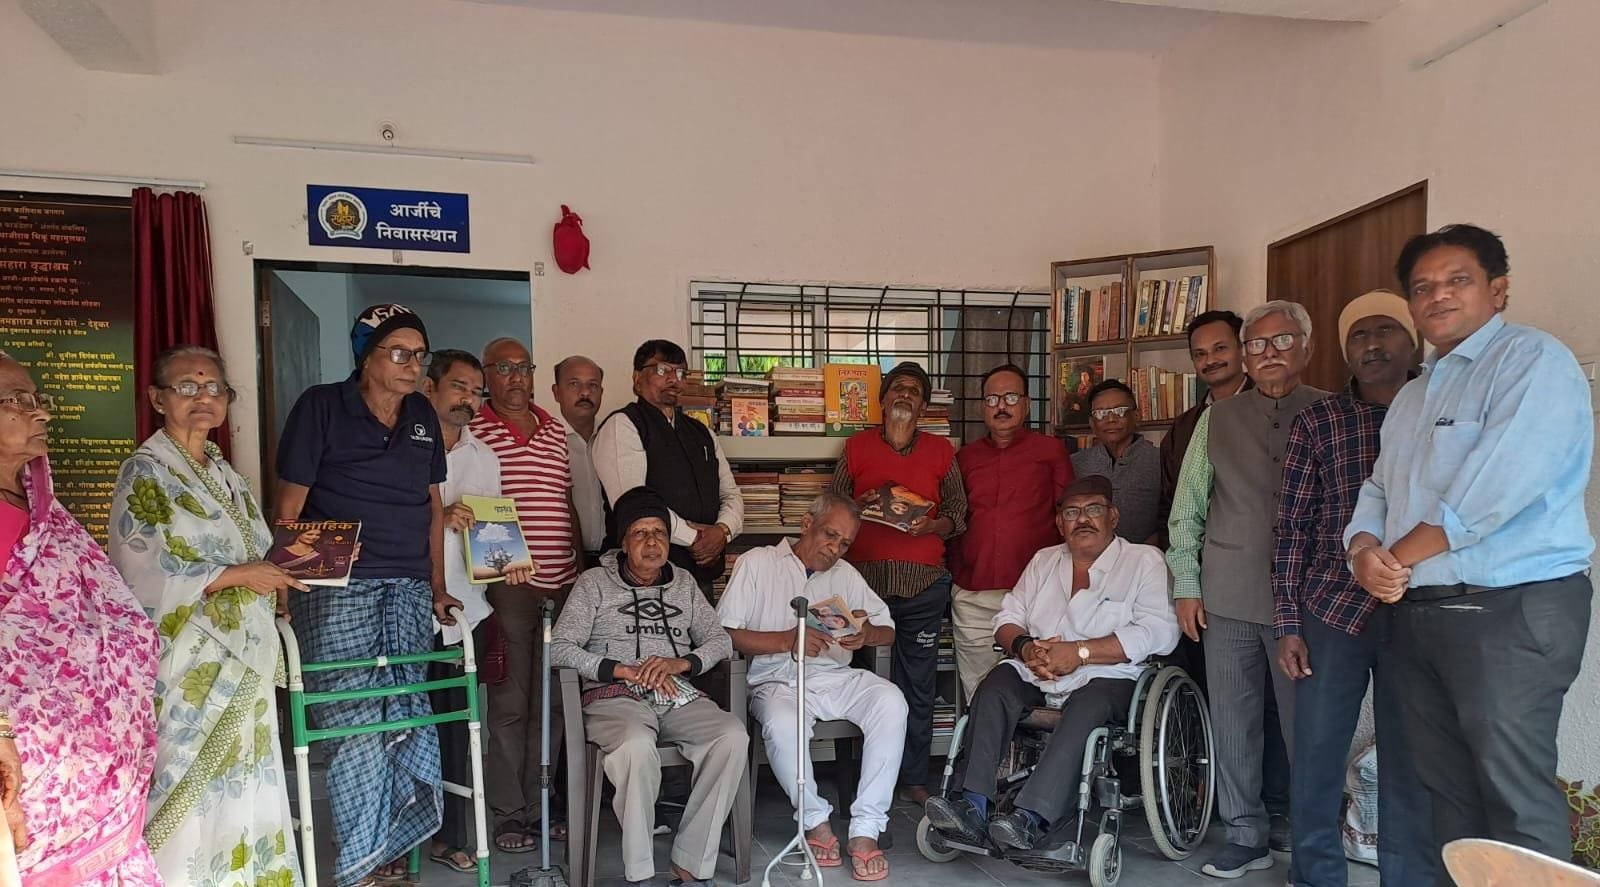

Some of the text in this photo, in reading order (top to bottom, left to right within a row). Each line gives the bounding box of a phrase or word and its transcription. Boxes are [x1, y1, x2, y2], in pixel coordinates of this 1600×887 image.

[390, 201, 442, 219] आजींचे
[376, 222, 457, 243] निवासस्थान
[29, 261, 69, 274] वृद्धाश्रम
